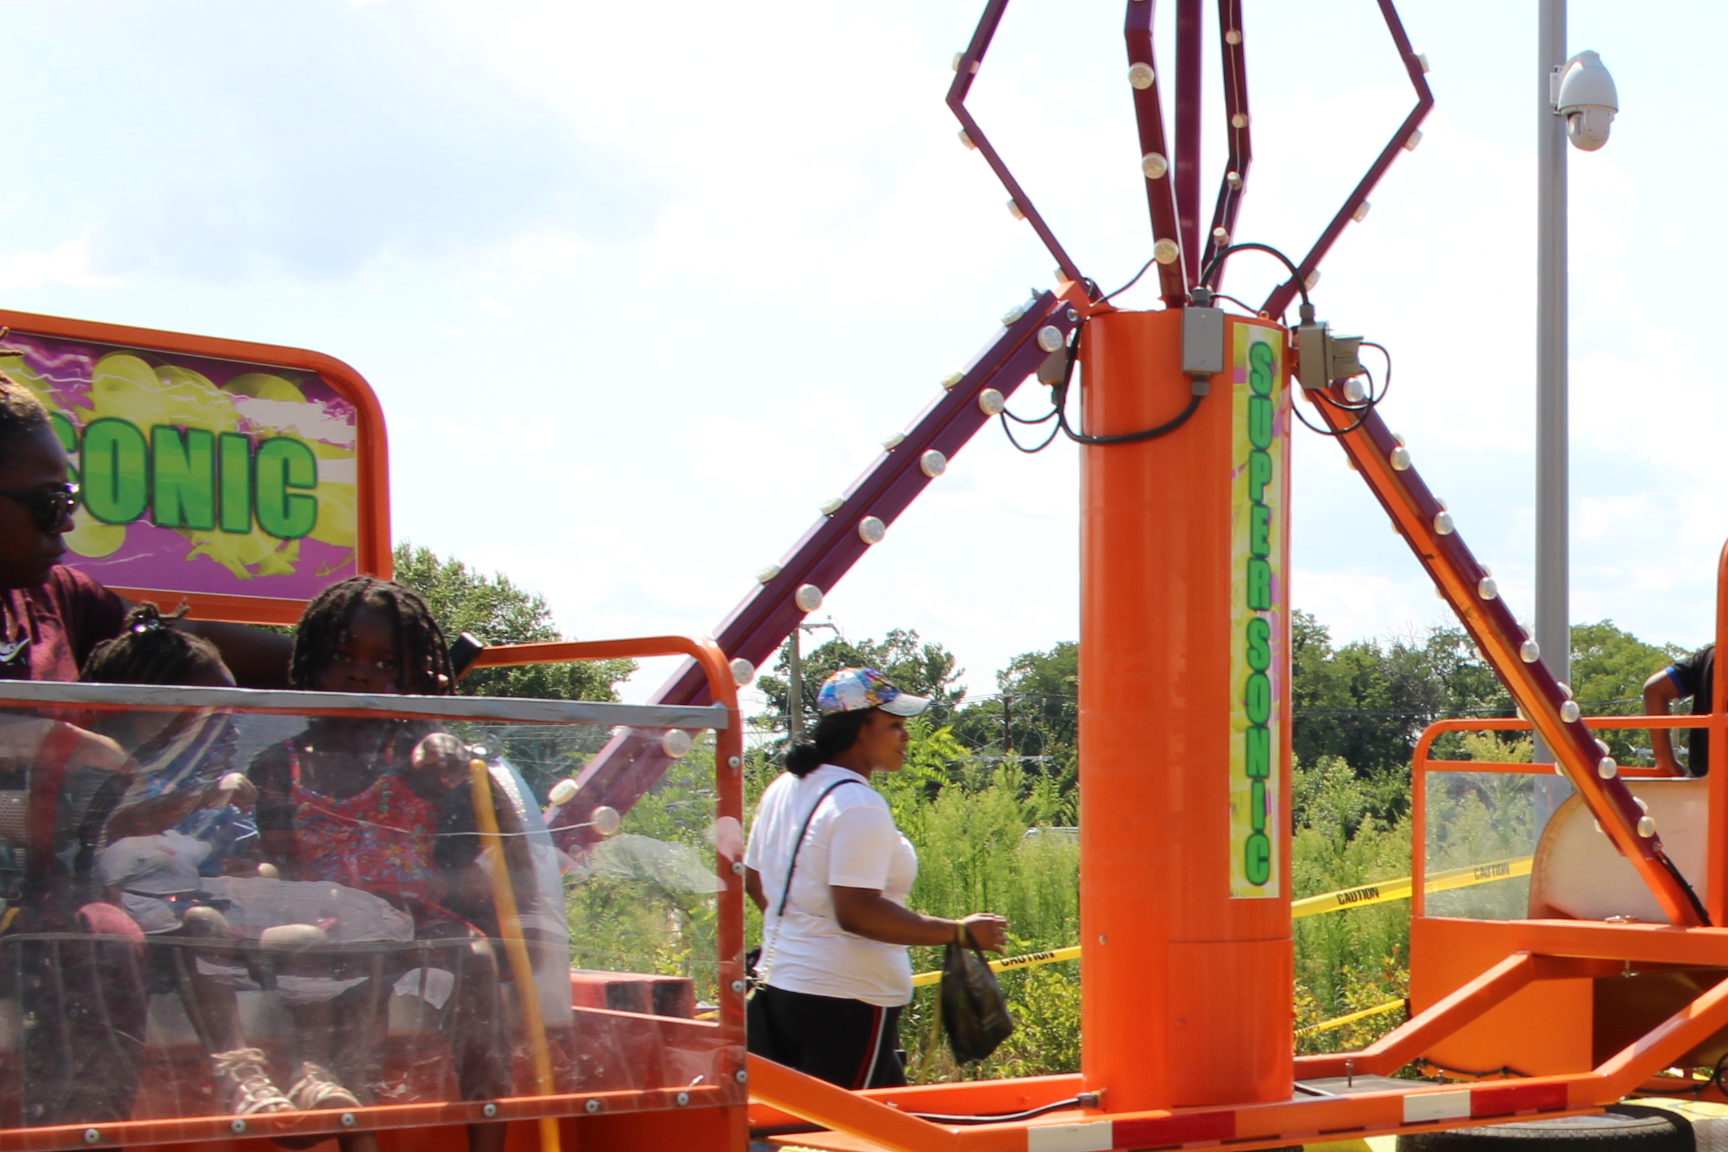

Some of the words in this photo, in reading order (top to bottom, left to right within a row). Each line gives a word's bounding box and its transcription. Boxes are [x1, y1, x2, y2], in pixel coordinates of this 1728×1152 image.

[1247, 340, 1274, 611] SUPER
[1245, 617, 1271, 886] SONIC
[1336, 886, 1380, 906] CAUTION
[1473, 862, 1510, 880] CAUTION
